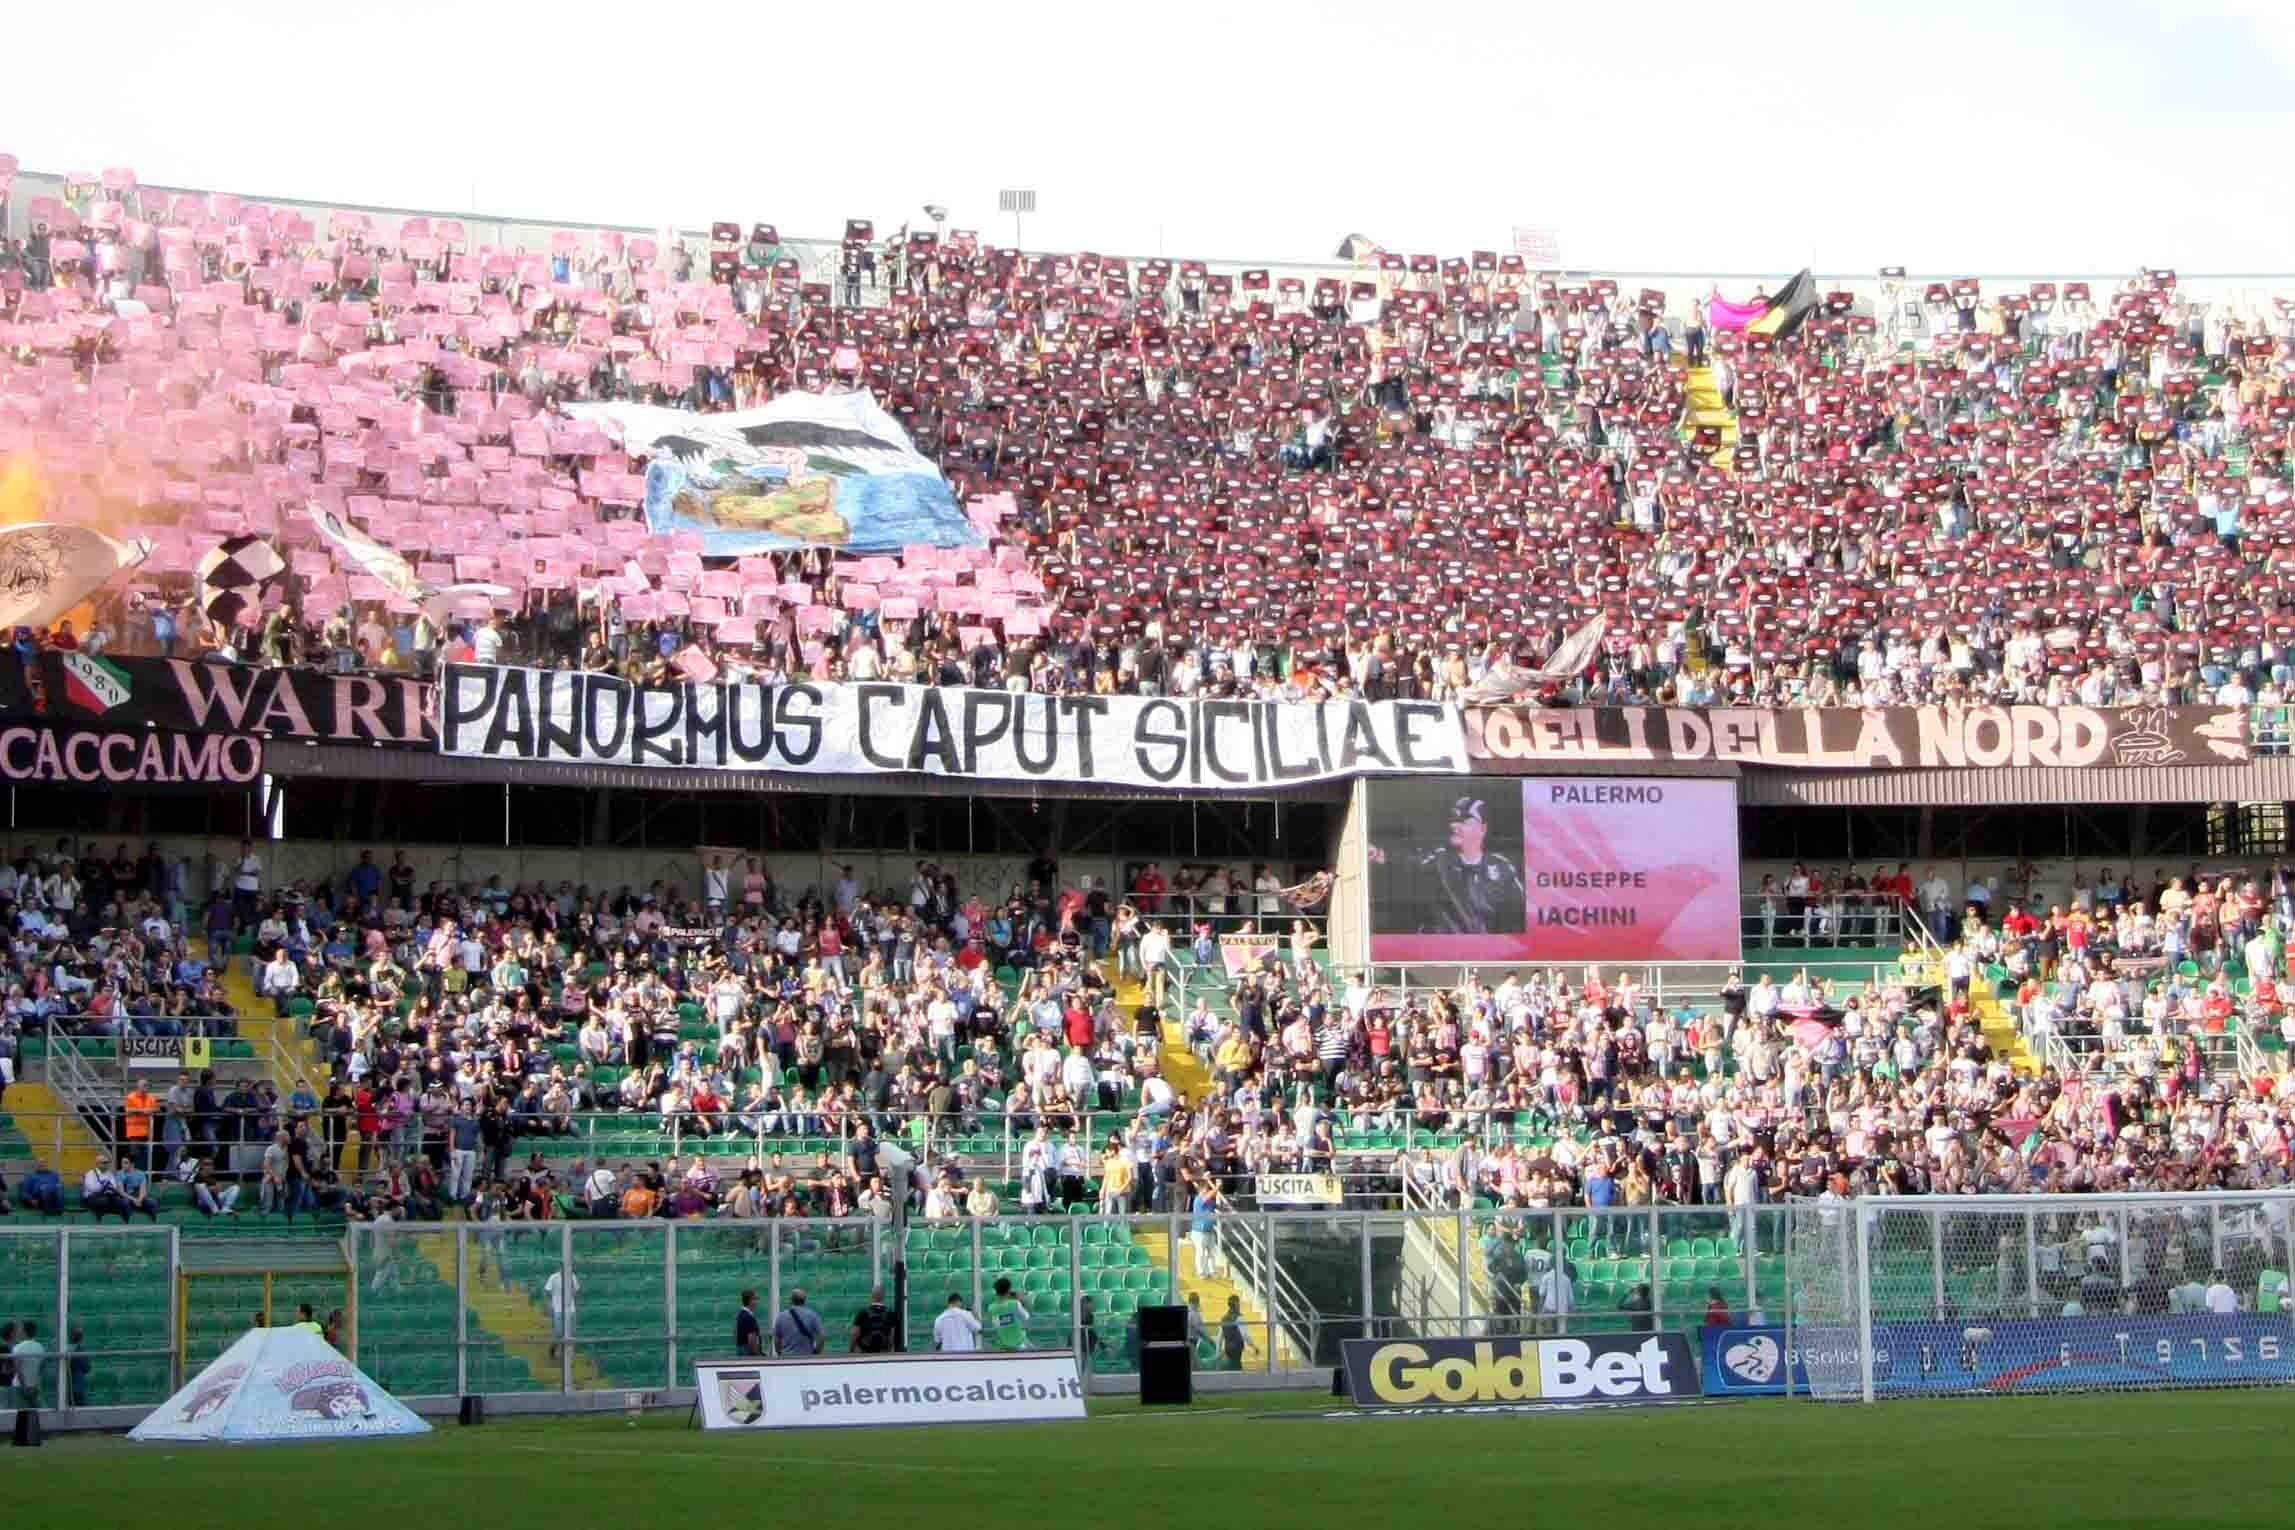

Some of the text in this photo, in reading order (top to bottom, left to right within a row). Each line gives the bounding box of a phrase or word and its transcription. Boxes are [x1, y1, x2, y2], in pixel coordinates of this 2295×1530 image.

[71, 654, 119, 704] 1980
[444, 663, 1452, 783] PANORMUS CAPUT SICILIAE
[1665, 705, 1904, 766] DELLA
[1917, 704, 2109, 768] NORD
[0, 726, 263, 783] CACCAMO
[1551, 785, 1664, 804] PALERMO
[1536, 871, 1648, 889] GIUSEPPE
[1537, 907, 1637, 926] IACHINI
[121, 1036, 183, 1057] USCITA
[1261, 1178, 1315, 1195] USCITA
[1369, 1335, 1672, 1403] GoldBet
[800, 1376, 1085, 1412] palermocalcio.it
